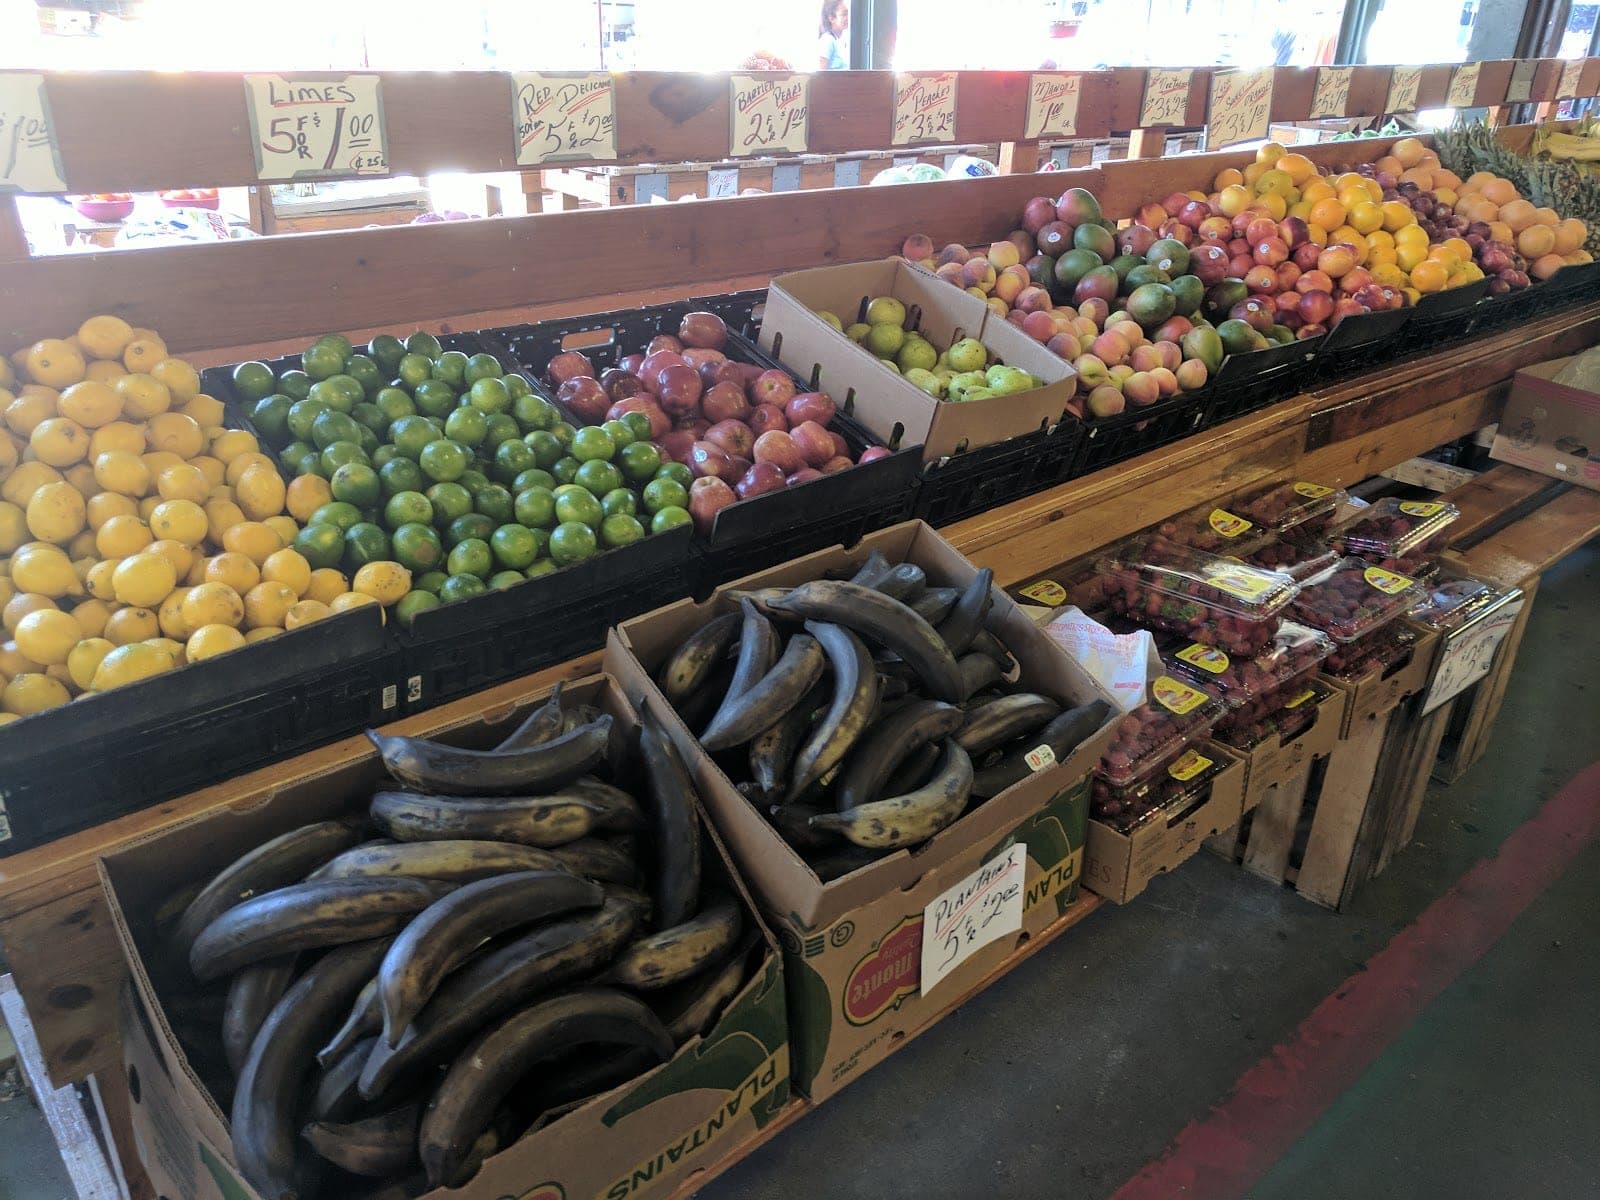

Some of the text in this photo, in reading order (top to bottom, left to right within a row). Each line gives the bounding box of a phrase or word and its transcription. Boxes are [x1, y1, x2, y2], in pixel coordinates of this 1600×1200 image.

[518, 83, 551, 115] RED
[1151, 97, 1165, 120] 3
[262, 117, 297, 154] 5
[539, 116, 568, 157] 5
[743, 113, 768, 146] 2
[910, 113, 925, 139] 3
[1219, 113, 1239, 144] 3
[1023, 858, 1074, 912] PLAN
[938, 915, 966, 972] 5
[606, 1059, 776, 1200] PLANTAINS
